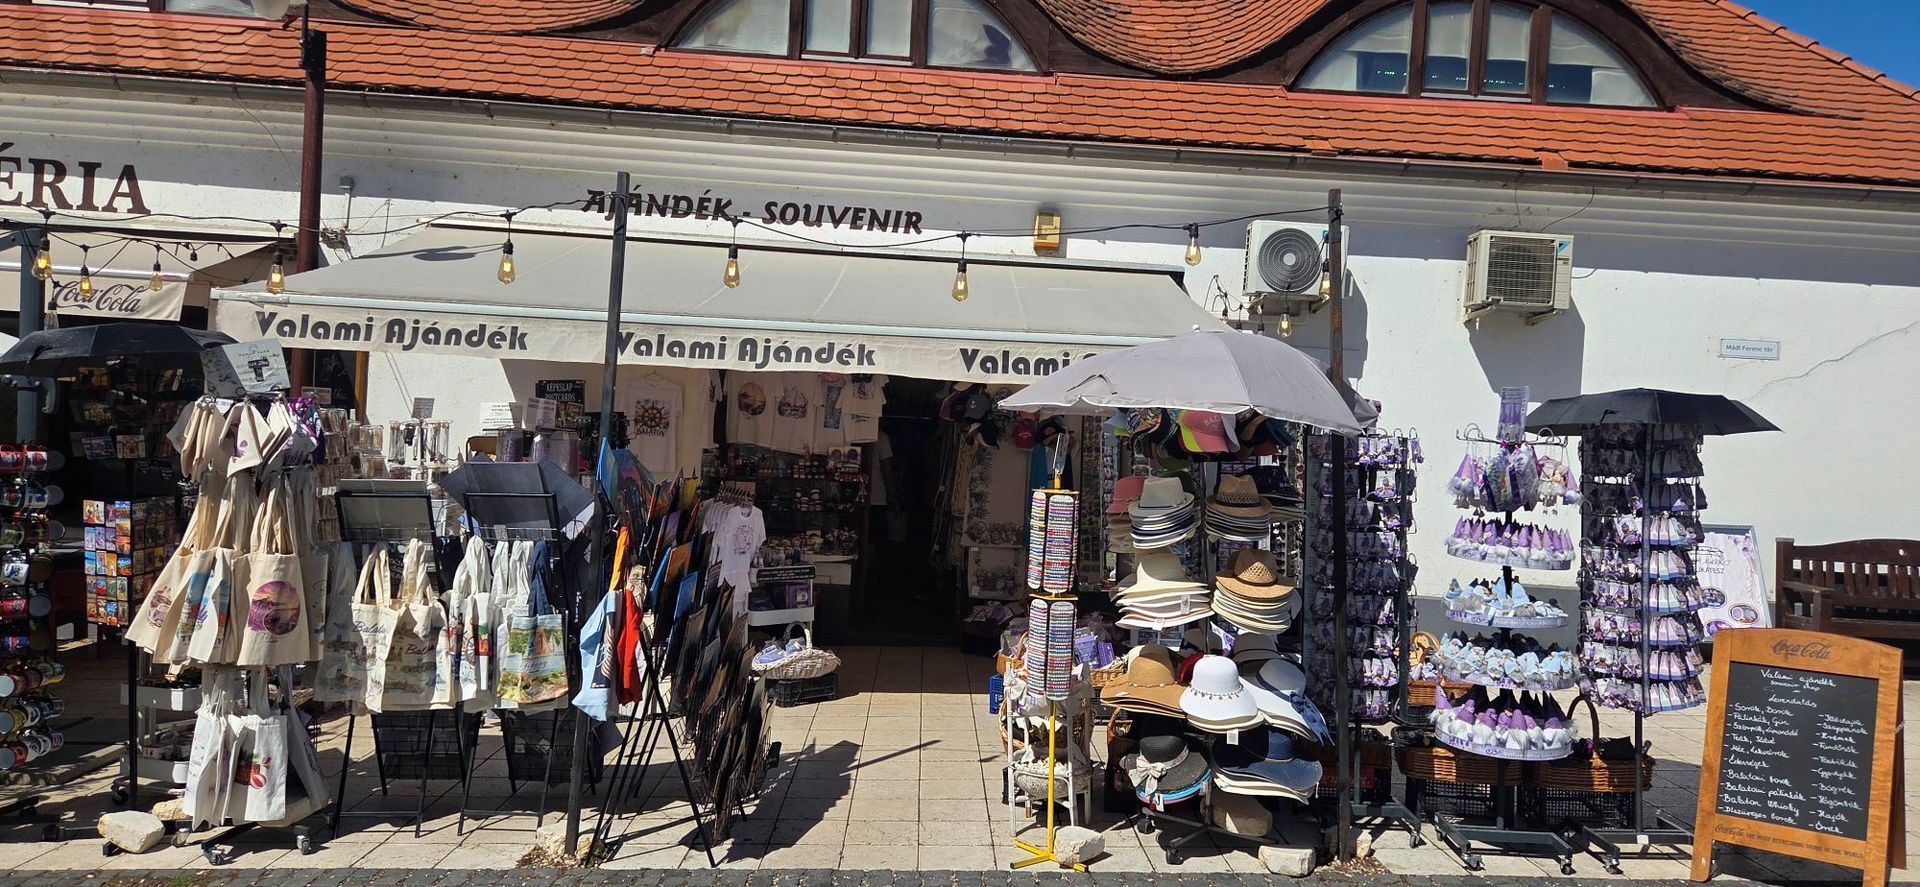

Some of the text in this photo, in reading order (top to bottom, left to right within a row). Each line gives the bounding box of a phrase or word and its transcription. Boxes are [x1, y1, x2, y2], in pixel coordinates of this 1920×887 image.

[762, 200, 923, 235] SOUVENIR
[256, 310, 529, 351] Valami Ajándék
[616, 331, 877, 369] Valami Ajándék
[1741, 344, 1763, 352] Ferenc
[1763, 345, 1774, 353] tér
[959, 347, 1071, 376] Valami
[1760, 668, 1794, 680] Valami
[1726, 768, 1766, 782] Balatoni
[1724, 782, 1766, 794] Balatoni
[1722, 793, 1762, 807] Balaton
